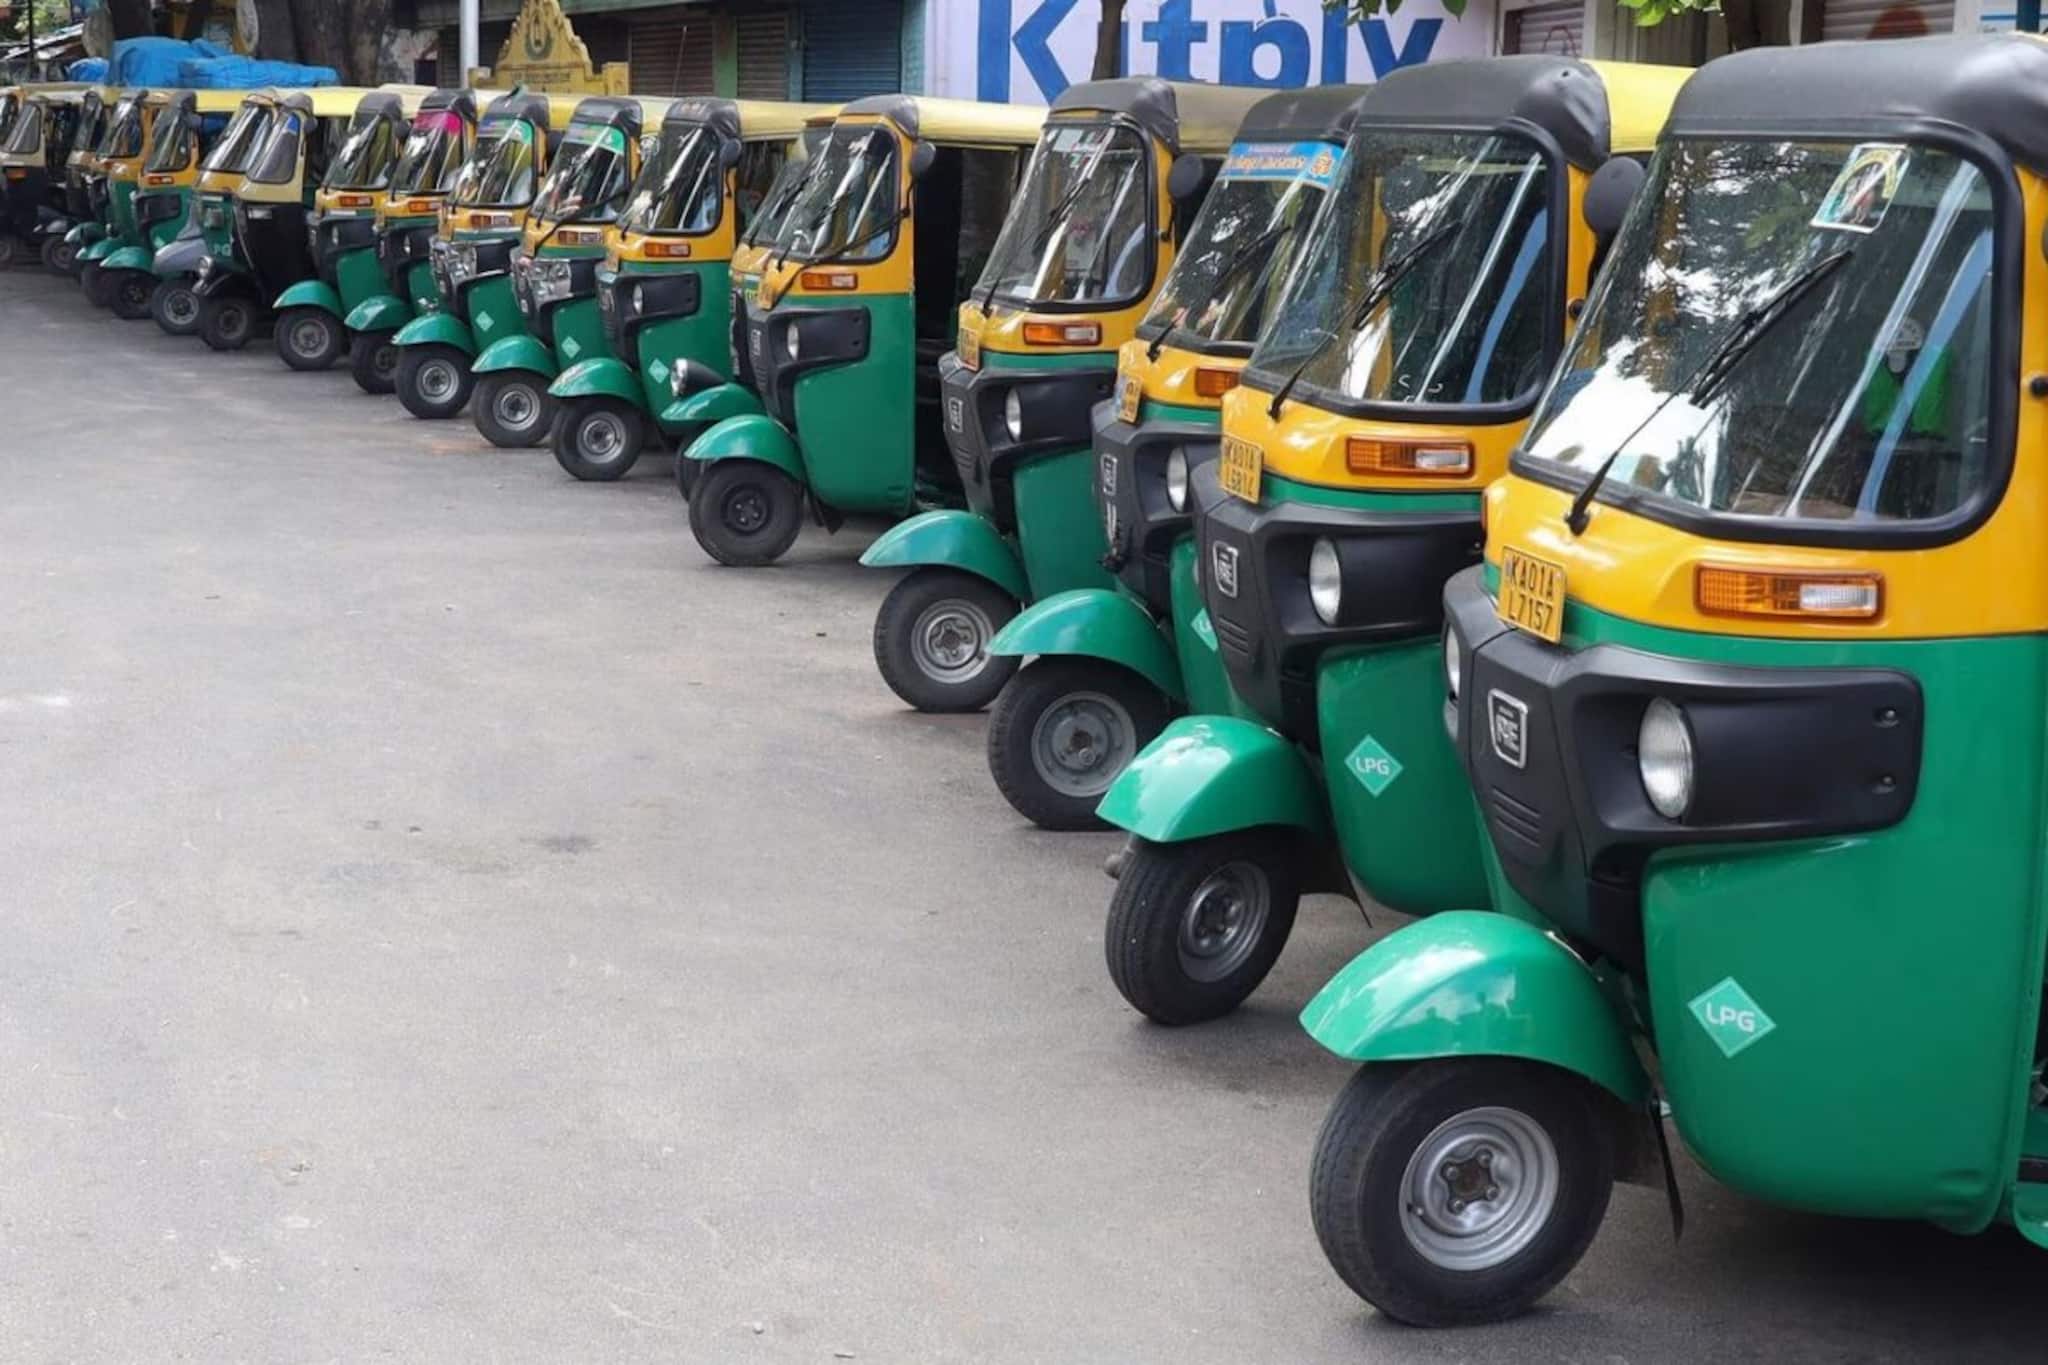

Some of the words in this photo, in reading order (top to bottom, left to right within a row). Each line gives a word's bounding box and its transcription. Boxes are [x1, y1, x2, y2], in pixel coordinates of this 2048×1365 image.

[1511, 554, 1555, 600] KA01A
[1508, 589, 1554, 634] L7157
[1355, 756, 1390, 776] LPG
[1706, 1001, 1756, 1034] LPG
